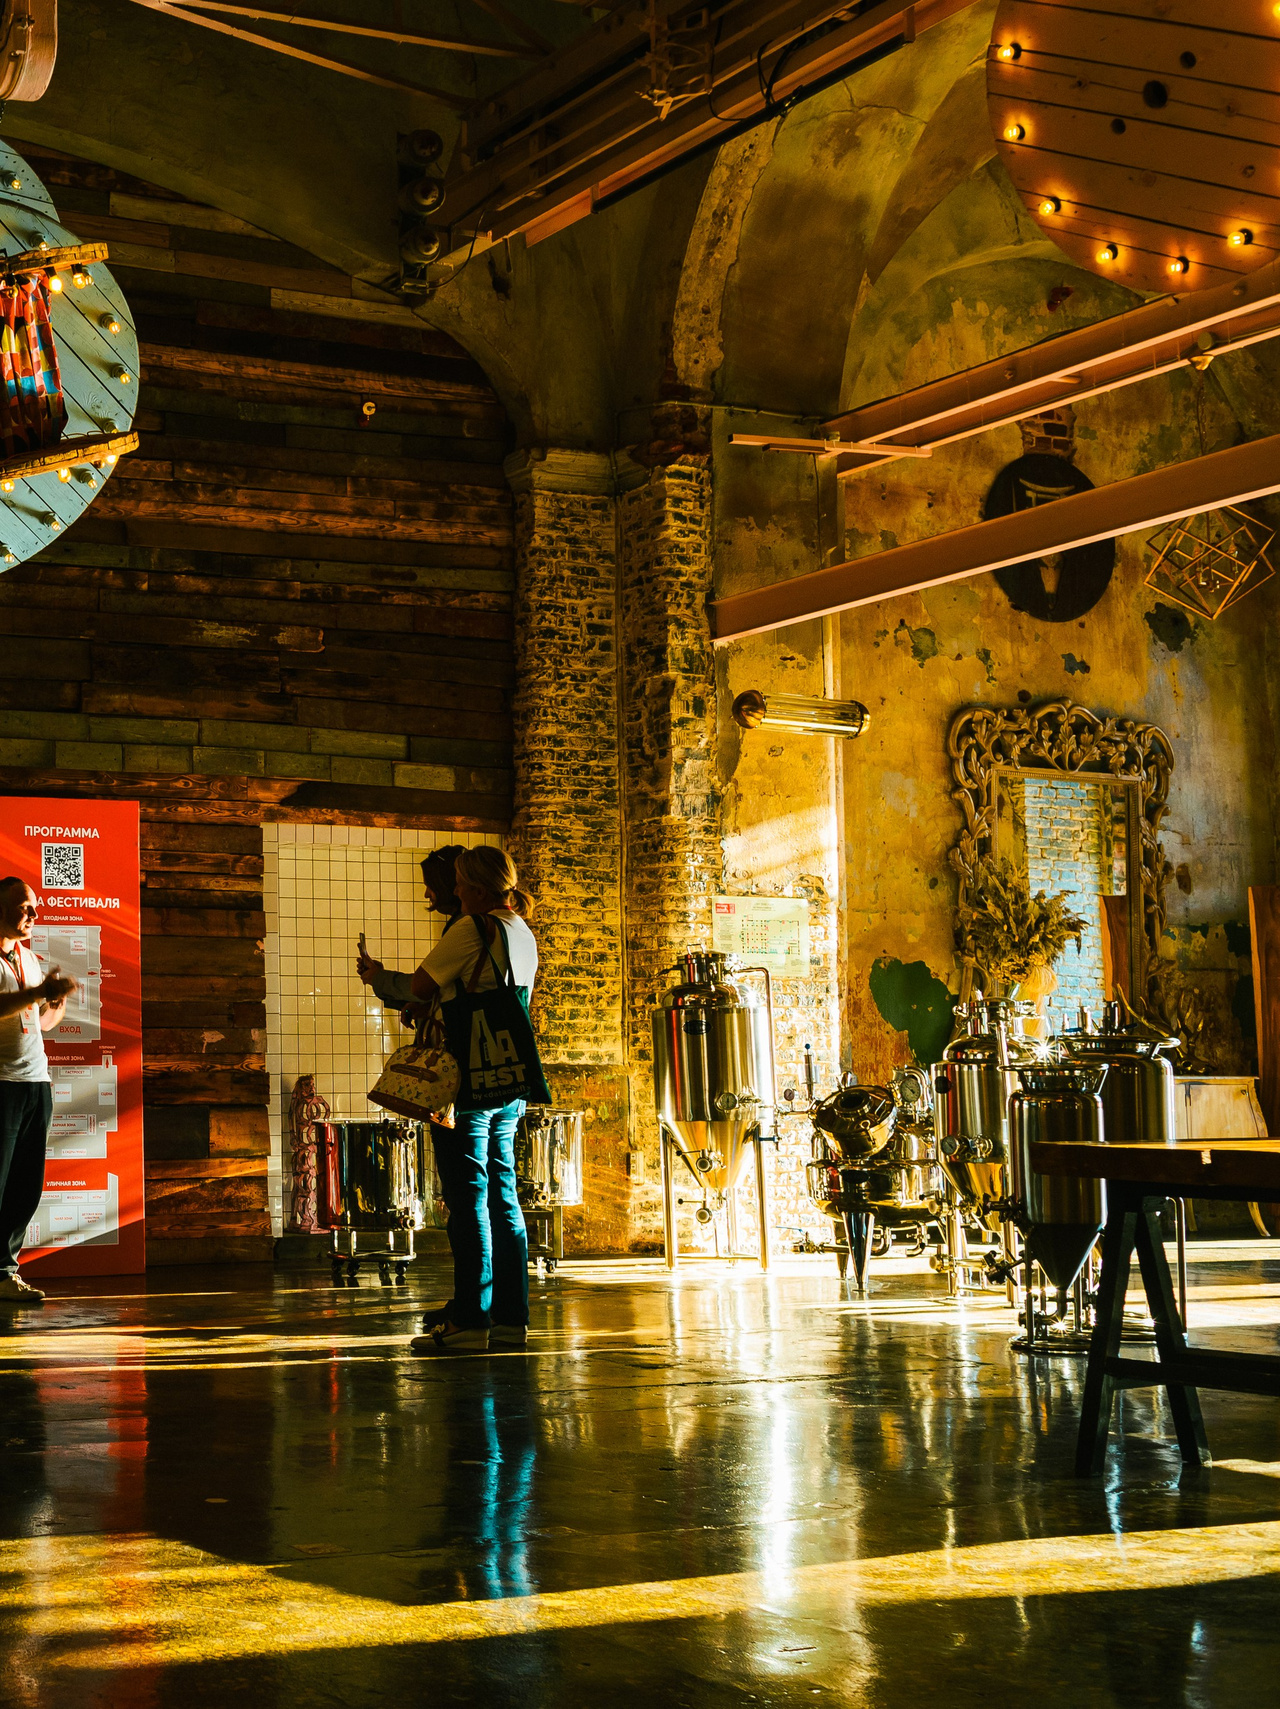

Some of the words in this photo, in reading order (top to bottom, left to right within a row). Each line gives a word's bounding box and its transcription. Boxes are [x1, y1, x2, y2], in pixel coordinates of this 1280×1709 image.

[24, 825, 100, 839] ПРОГРАММА
[47, 896, 120, 909] ФЕСТИВАЛЯ
[60, 1026, 81, 1034] ВХОД
[470, 1064, 526, 1090] FEST
